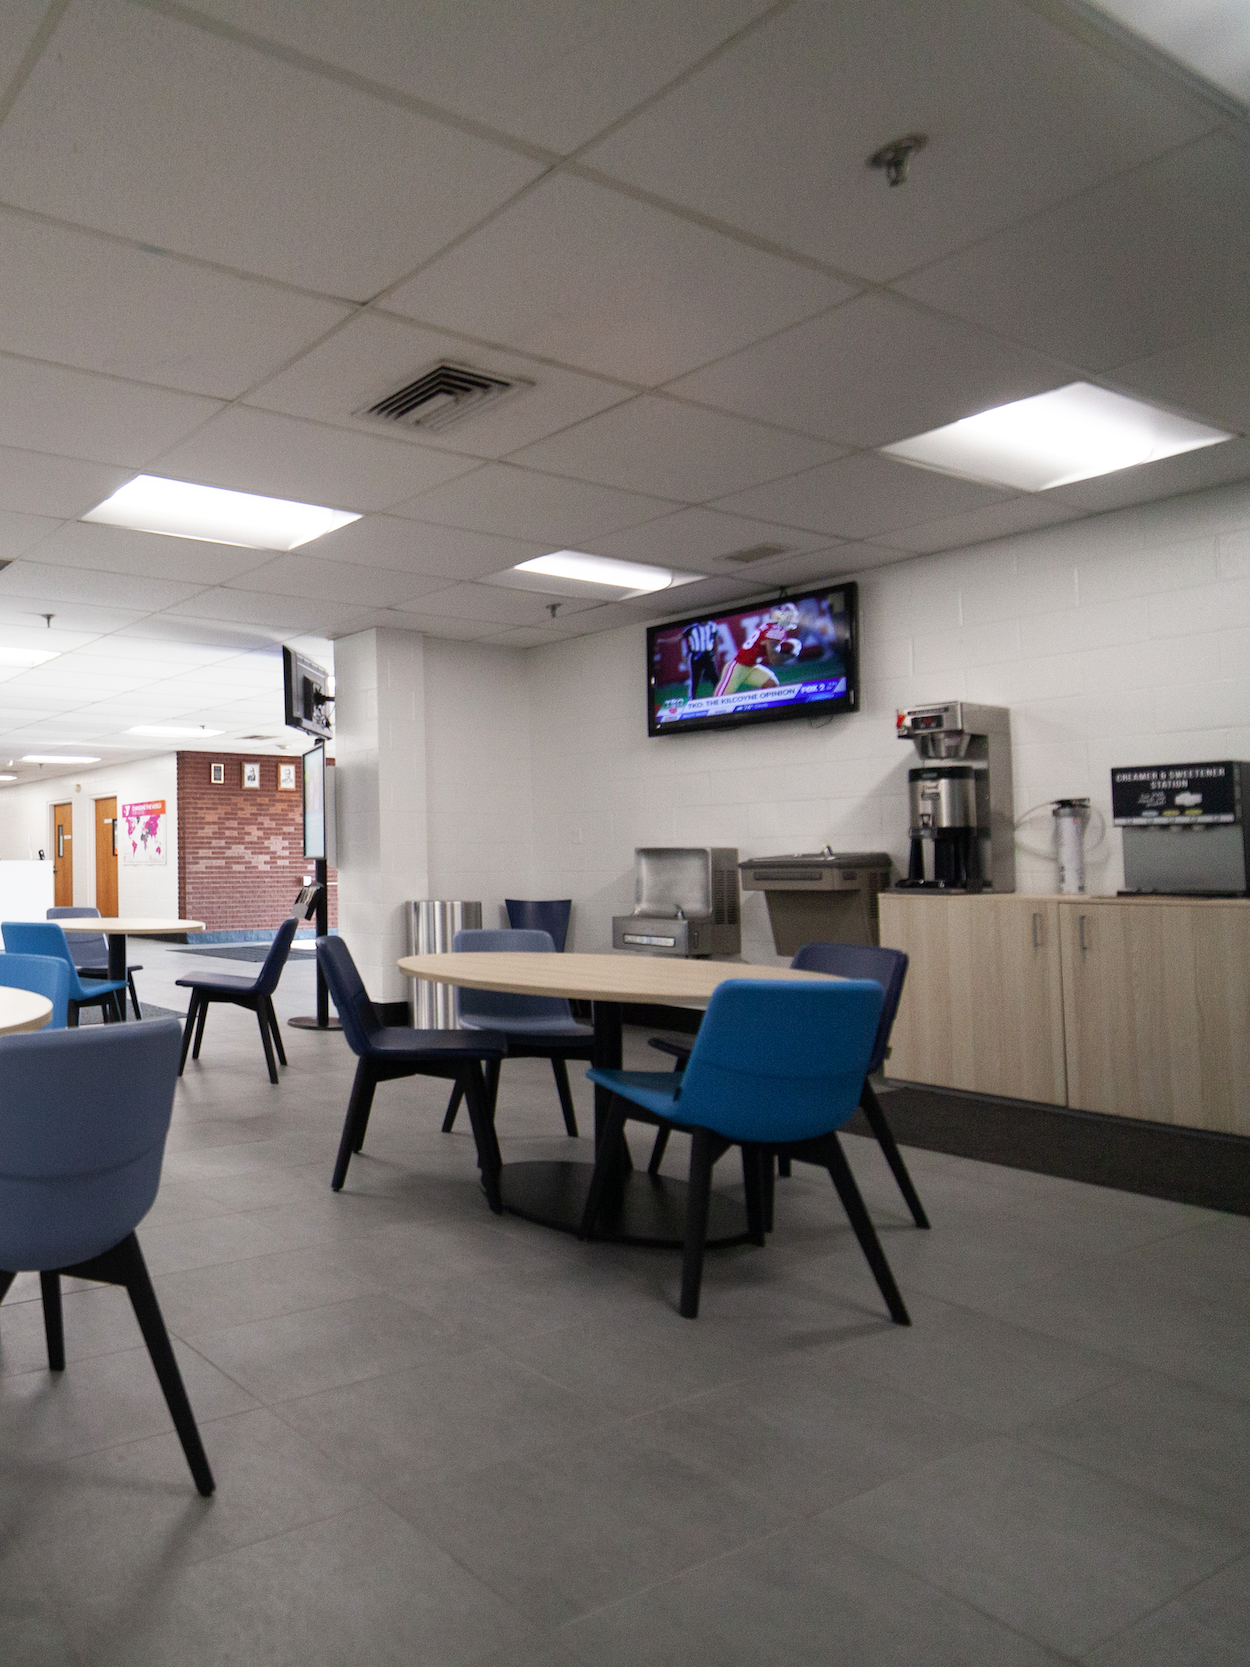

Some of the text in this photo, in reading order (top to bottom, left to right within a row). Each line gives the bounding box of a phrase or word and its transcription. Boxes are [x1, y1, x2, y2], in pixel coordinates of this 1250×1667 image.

[759, 688, 795, 698] OPINION
[1115, 771, 1158, 783] CREAMER
[1169, 766, 1225, 780] SWEETENER
[1150, 779, 1188, 790] STATION
